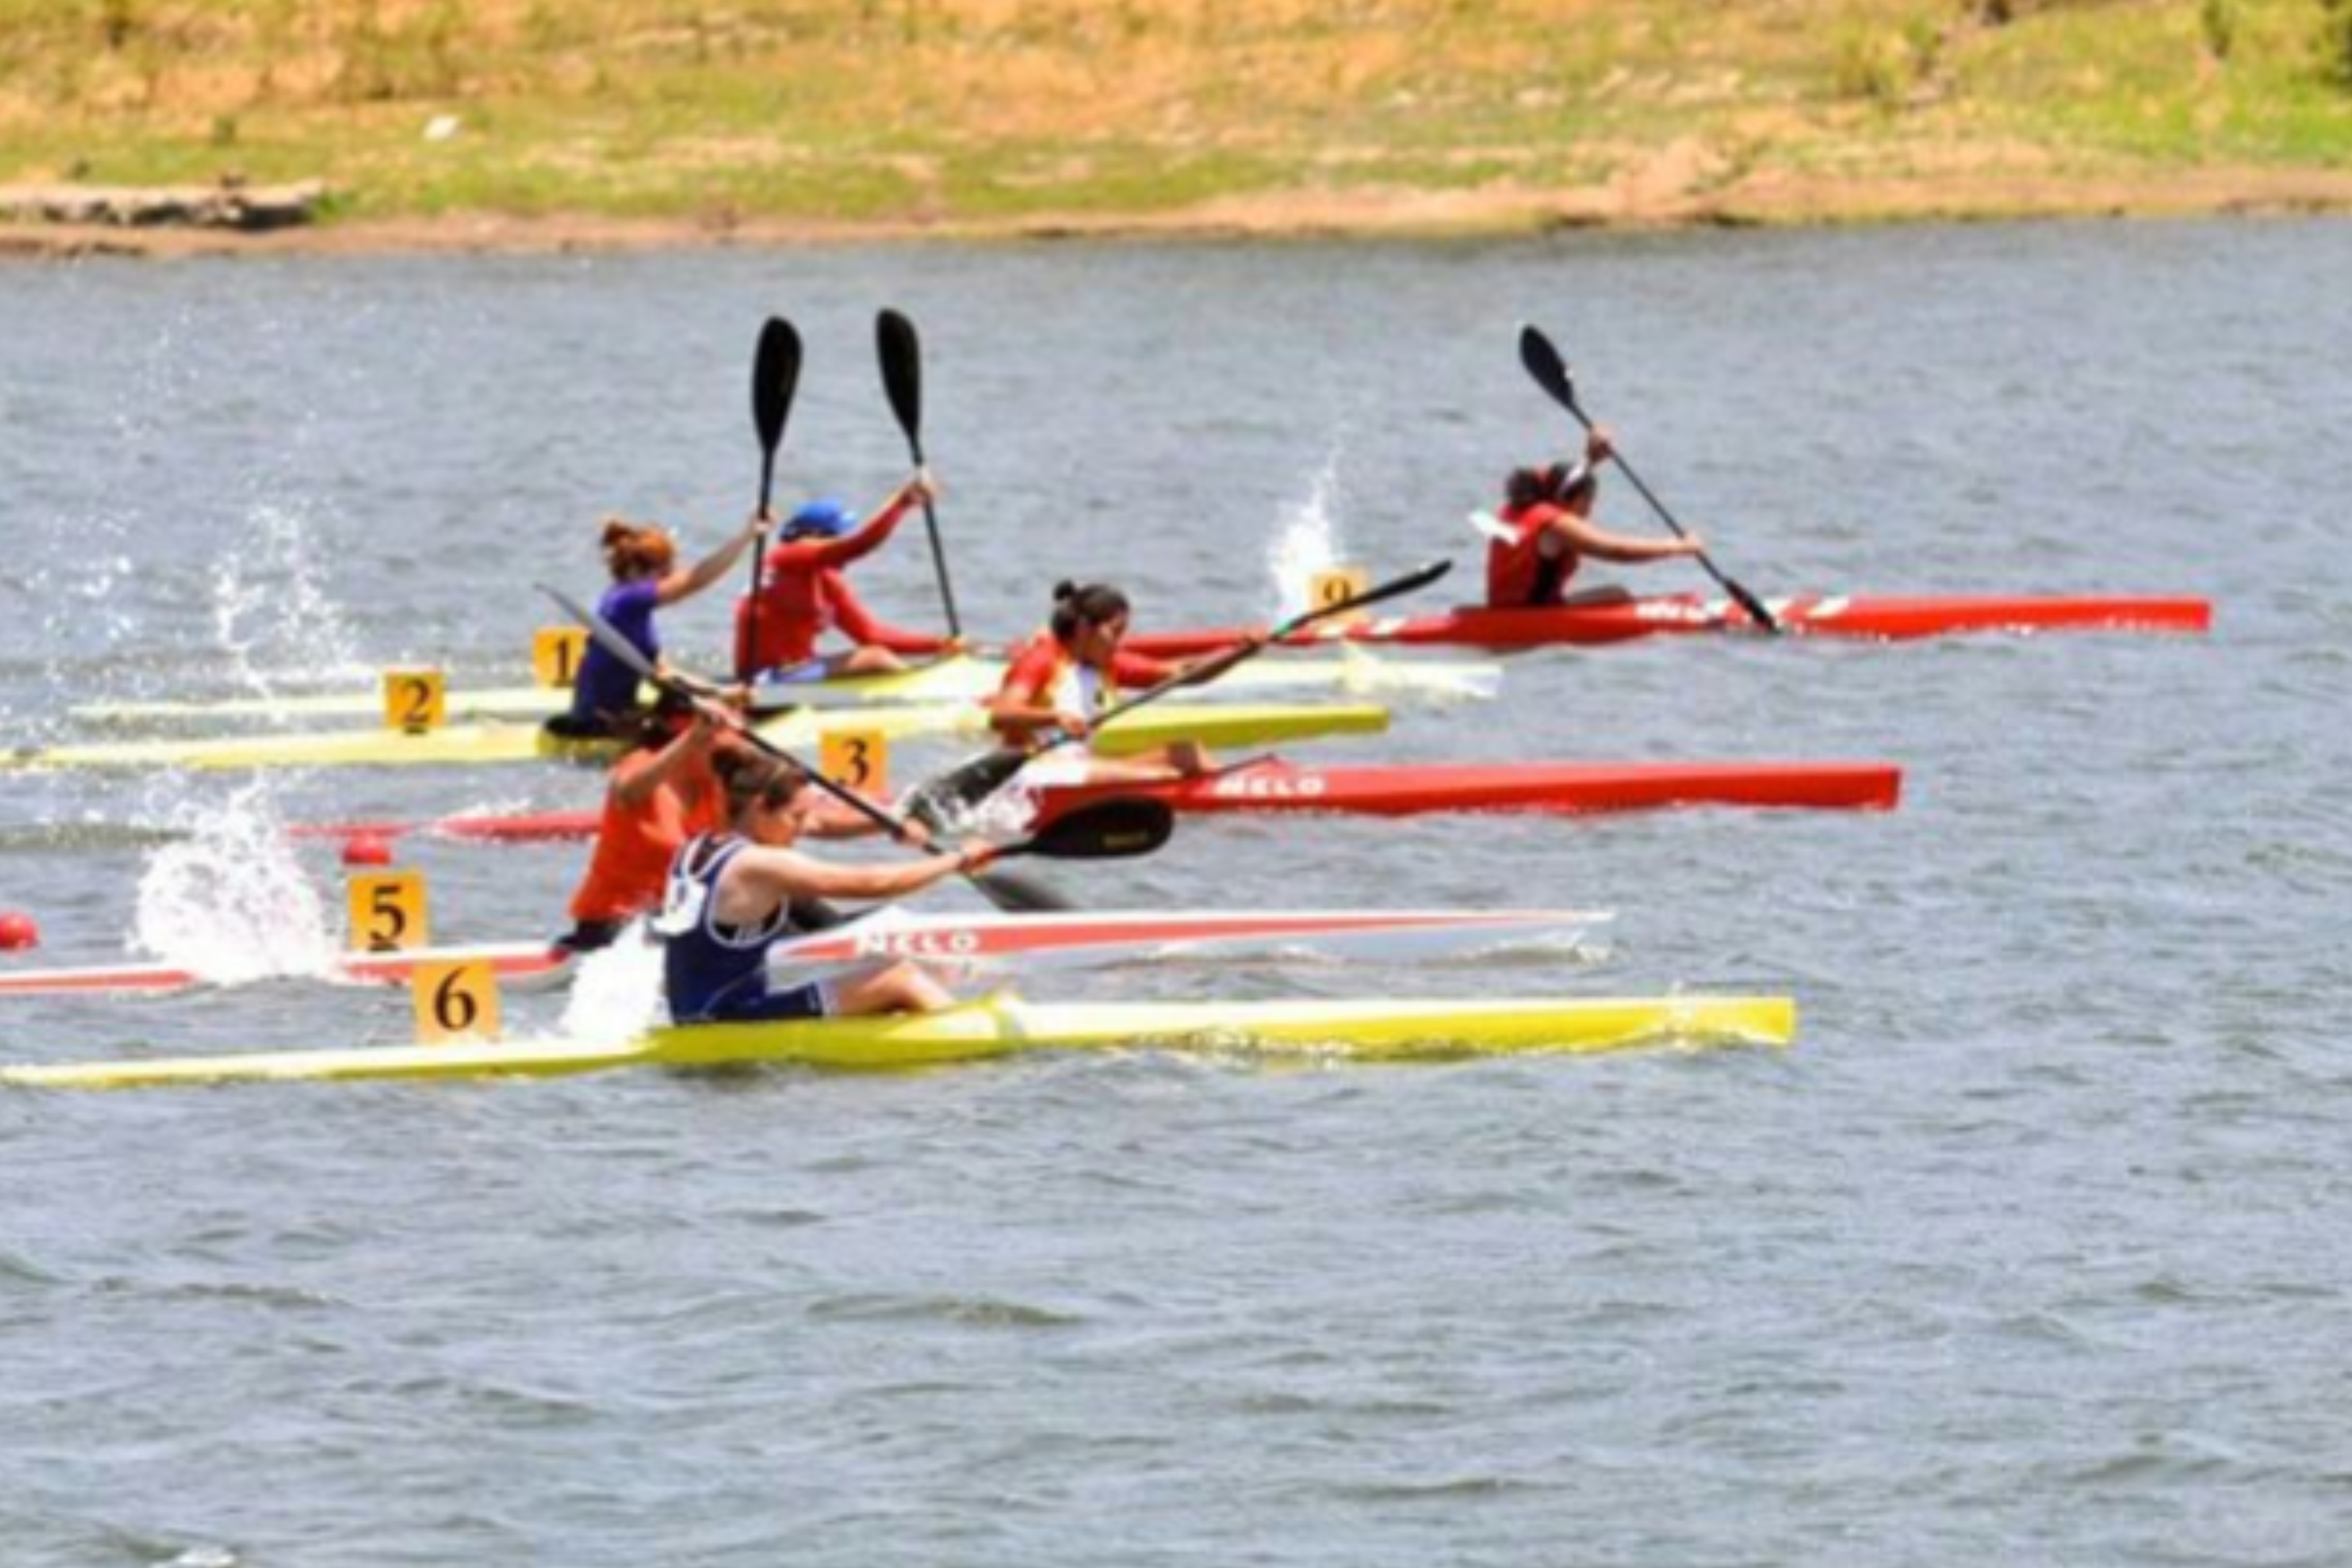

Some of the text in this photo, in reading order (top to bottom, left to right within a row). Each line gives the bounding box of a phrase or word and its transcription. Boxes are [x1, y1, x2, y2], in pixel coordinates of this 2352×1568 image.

[551, 637, 573, 684] 1
[402, 679, 431, 725] 2
[838, 737, 869, 788] 3
[1215, 775, 1325, 799] NELO
[369, 884, 407, 944] 5
[856, 931, 979, 957] NELO
[434, 967, 478, 1032] 6
